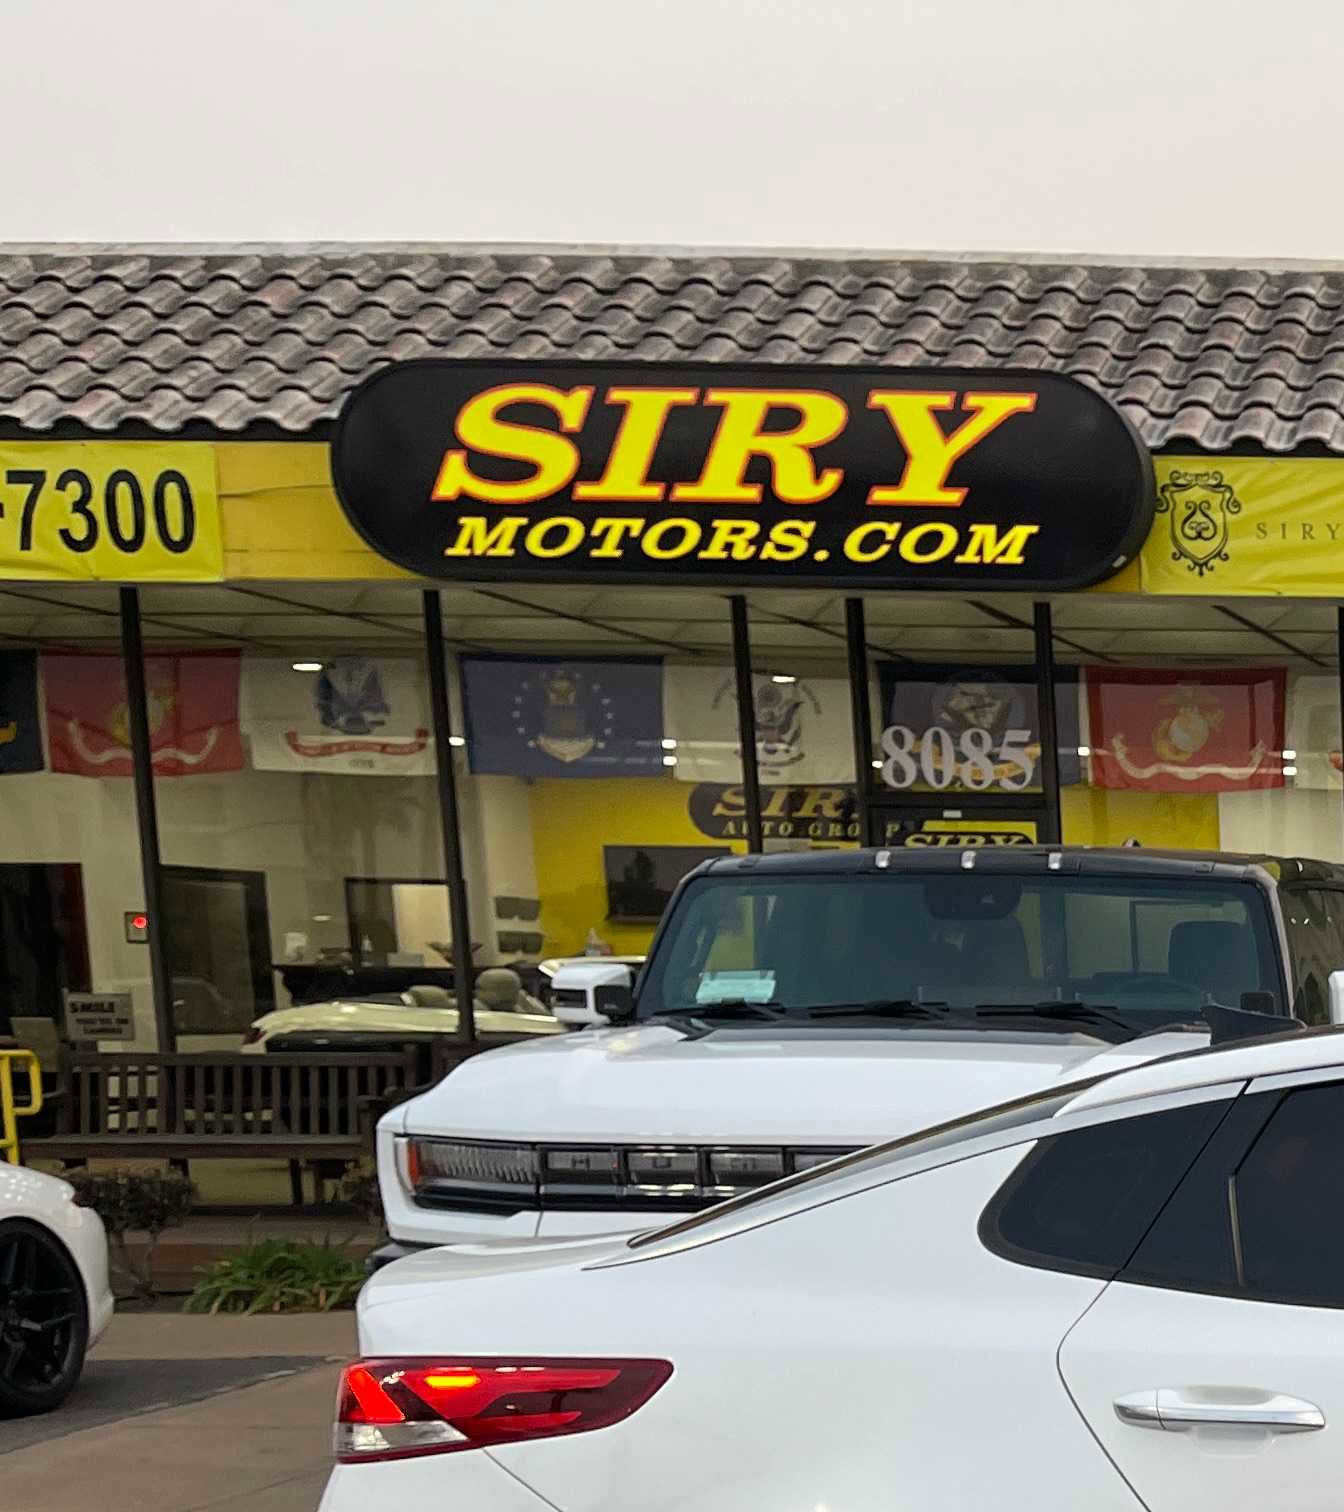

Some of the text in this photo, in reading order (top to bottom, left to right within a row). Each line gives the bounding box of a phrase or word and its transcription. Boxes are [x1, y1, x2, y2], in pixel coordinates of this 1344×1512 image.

[431, 382, 1038, 507] SIRY
[0, 469, 195, 553] 7300
[1255, 522, 1342, 541] SIRY
[444, 516, 1039, 565] MOTORS.COM
[881, 725, 1034, 791] 8085
[712, 786, 859, 818] SIR
